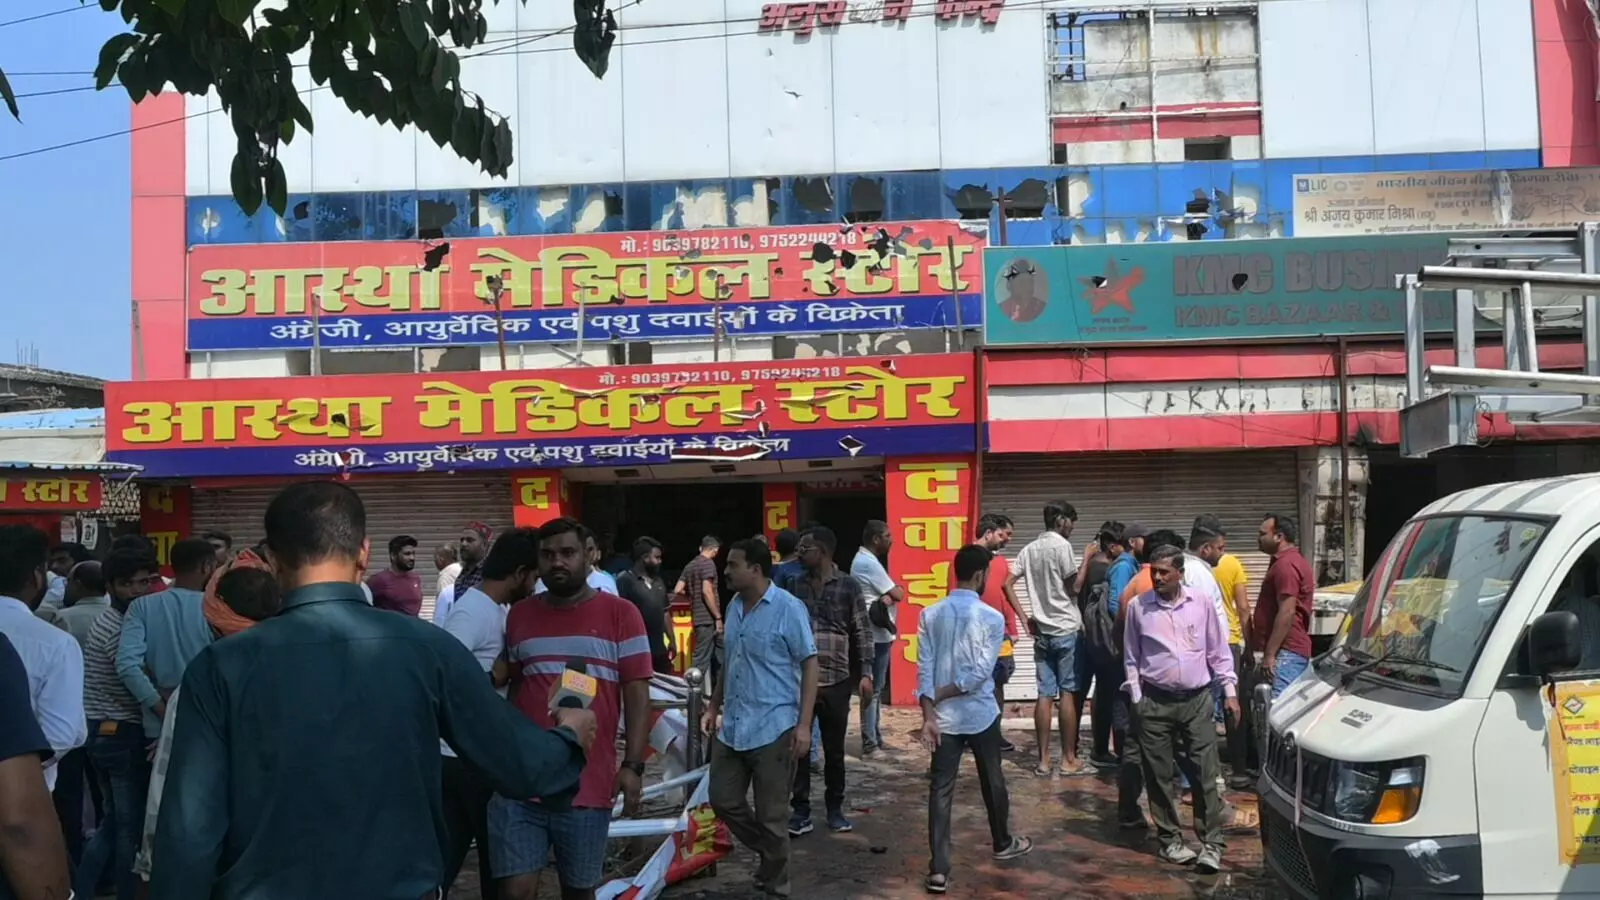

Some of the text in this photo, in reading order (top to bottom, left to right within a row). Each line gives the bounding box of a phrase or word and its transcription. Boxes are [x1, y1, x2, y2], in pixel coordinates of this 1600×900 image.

[1321, 209, 1351, 222] अजय
[1353, 208, 1385, 224] कुमार
[200, 264, 450, 316] आस्था
[470, 246, 779, 307] मेडिकल
[1173, 253, 1274, 296] KMC
[269, 319, 372, 341] अंग्रेजी,
[384, 313, 532, 341] आयुर्वेदिक
[539, 312, 581, 334] एवं
[590, 312, 641, 335] पशु
[766, 303, 798, 323] के
[805, 302, 905, 323] विक्रेता
[1176, 305, 1241, 327] KMC
[1246, 302, 1361, 326] BAZAAR
[122, 365, 966, 442] आस्था मेडिकल स्टोर
[504, 442, 541, 464] एवं
[544, 444, 584, 464] पशु
